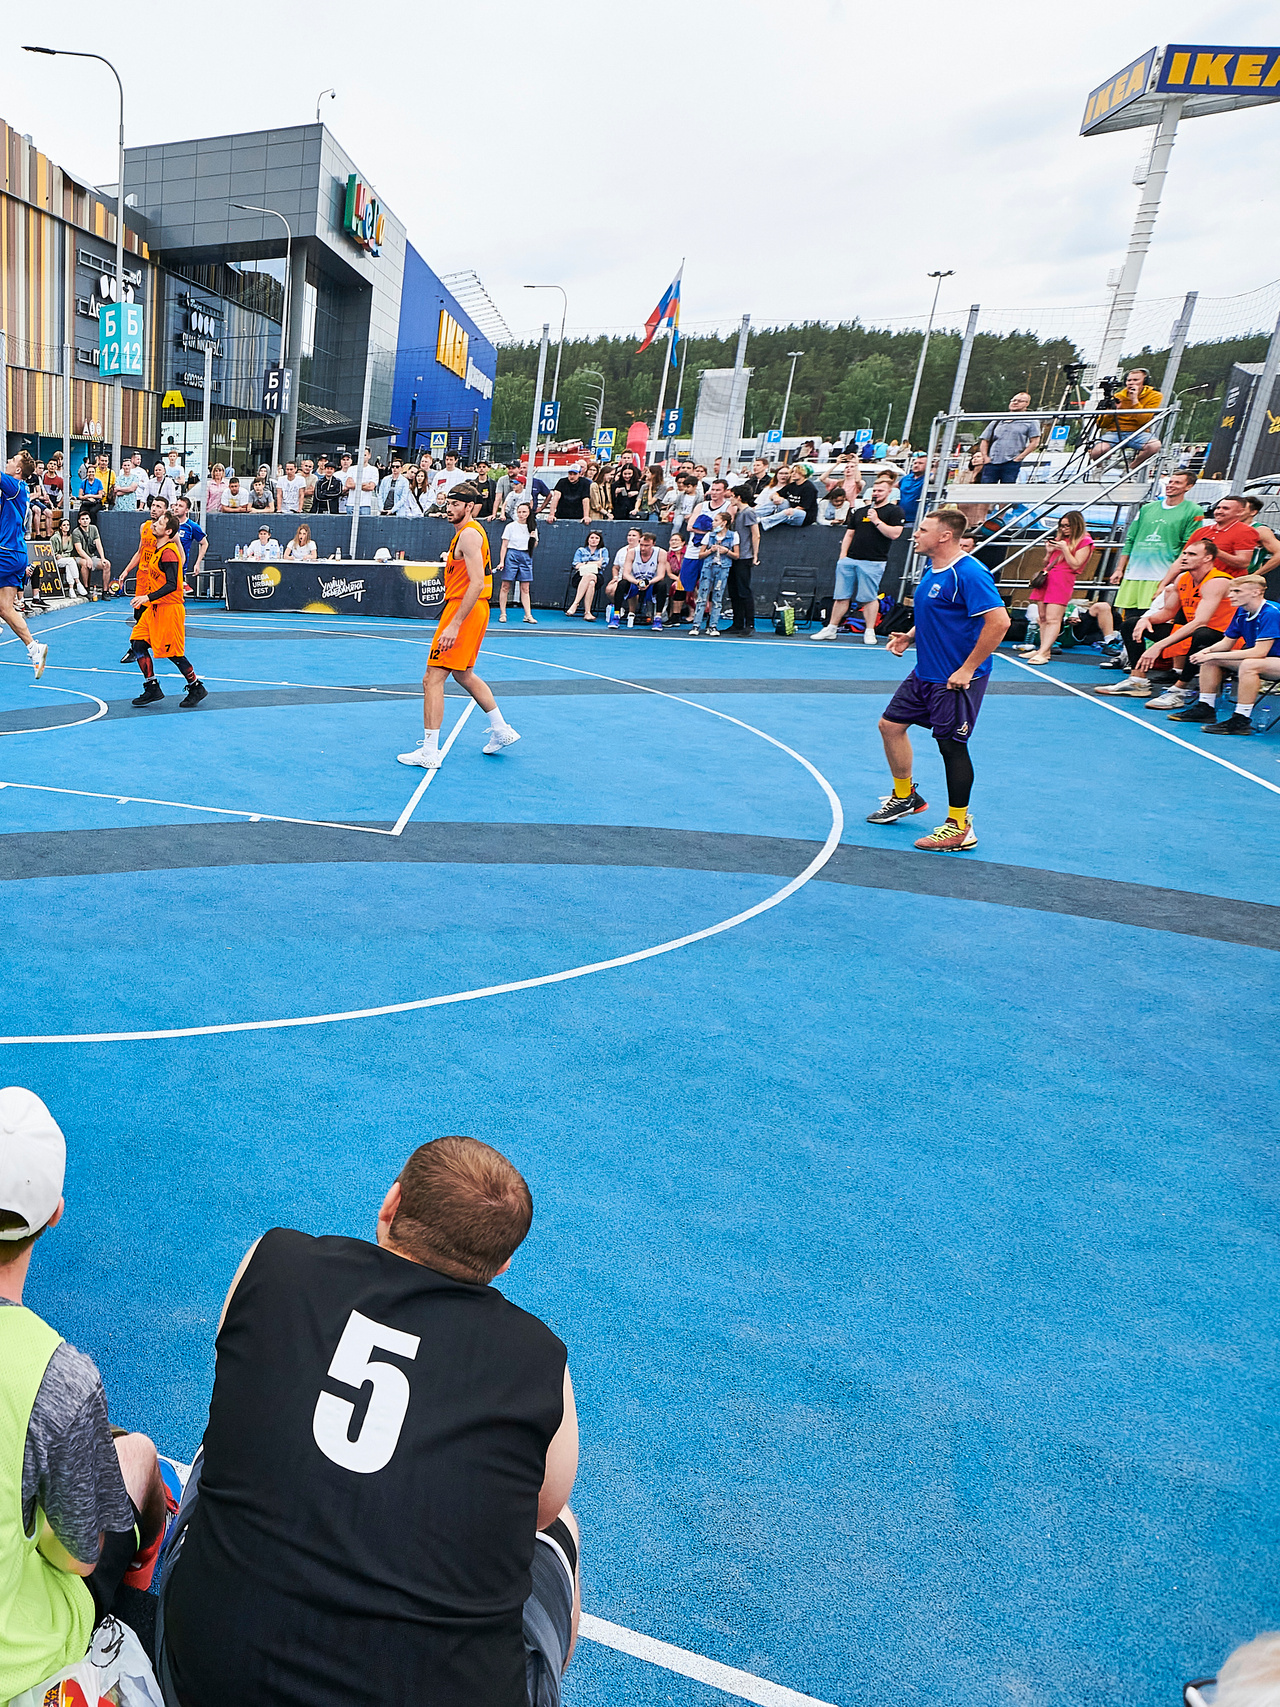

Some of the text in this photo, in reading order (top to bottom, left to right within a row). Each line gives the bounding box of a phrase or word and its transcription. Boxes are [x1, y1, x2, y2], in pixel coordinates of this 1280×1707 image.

[1083, 60, 1146, 126] IKEA
[105, 310, 116, 337] Б
[127, 309, 138, 336] Б
[102, 342, 120, 371] 12
[123, 341, 141, 370] 12
[268, 372, 279, 389] Б
[264, 392, 278, 410] 11
[282, 392, 290, 410] 11
[543, 404, 554, 417] Б
[669, 410, 678, 421] Б
[540, 419, 555, 432] 10
[668, 423, 676, 433] 9
[251, 573, 270, 582] MEGA
[252, 579, 275, 588] URBAN
[421, 579, 441, 587] MEGA
[253, 587, 269, 595] FEST
[421, 585, 446, 594] URBAN
[422, 593, 440, 602] FEST
[164, 644, 171, 653] 7
[429, 649, 441, 660] 12
[312, 1308, 422, 1474] 5
